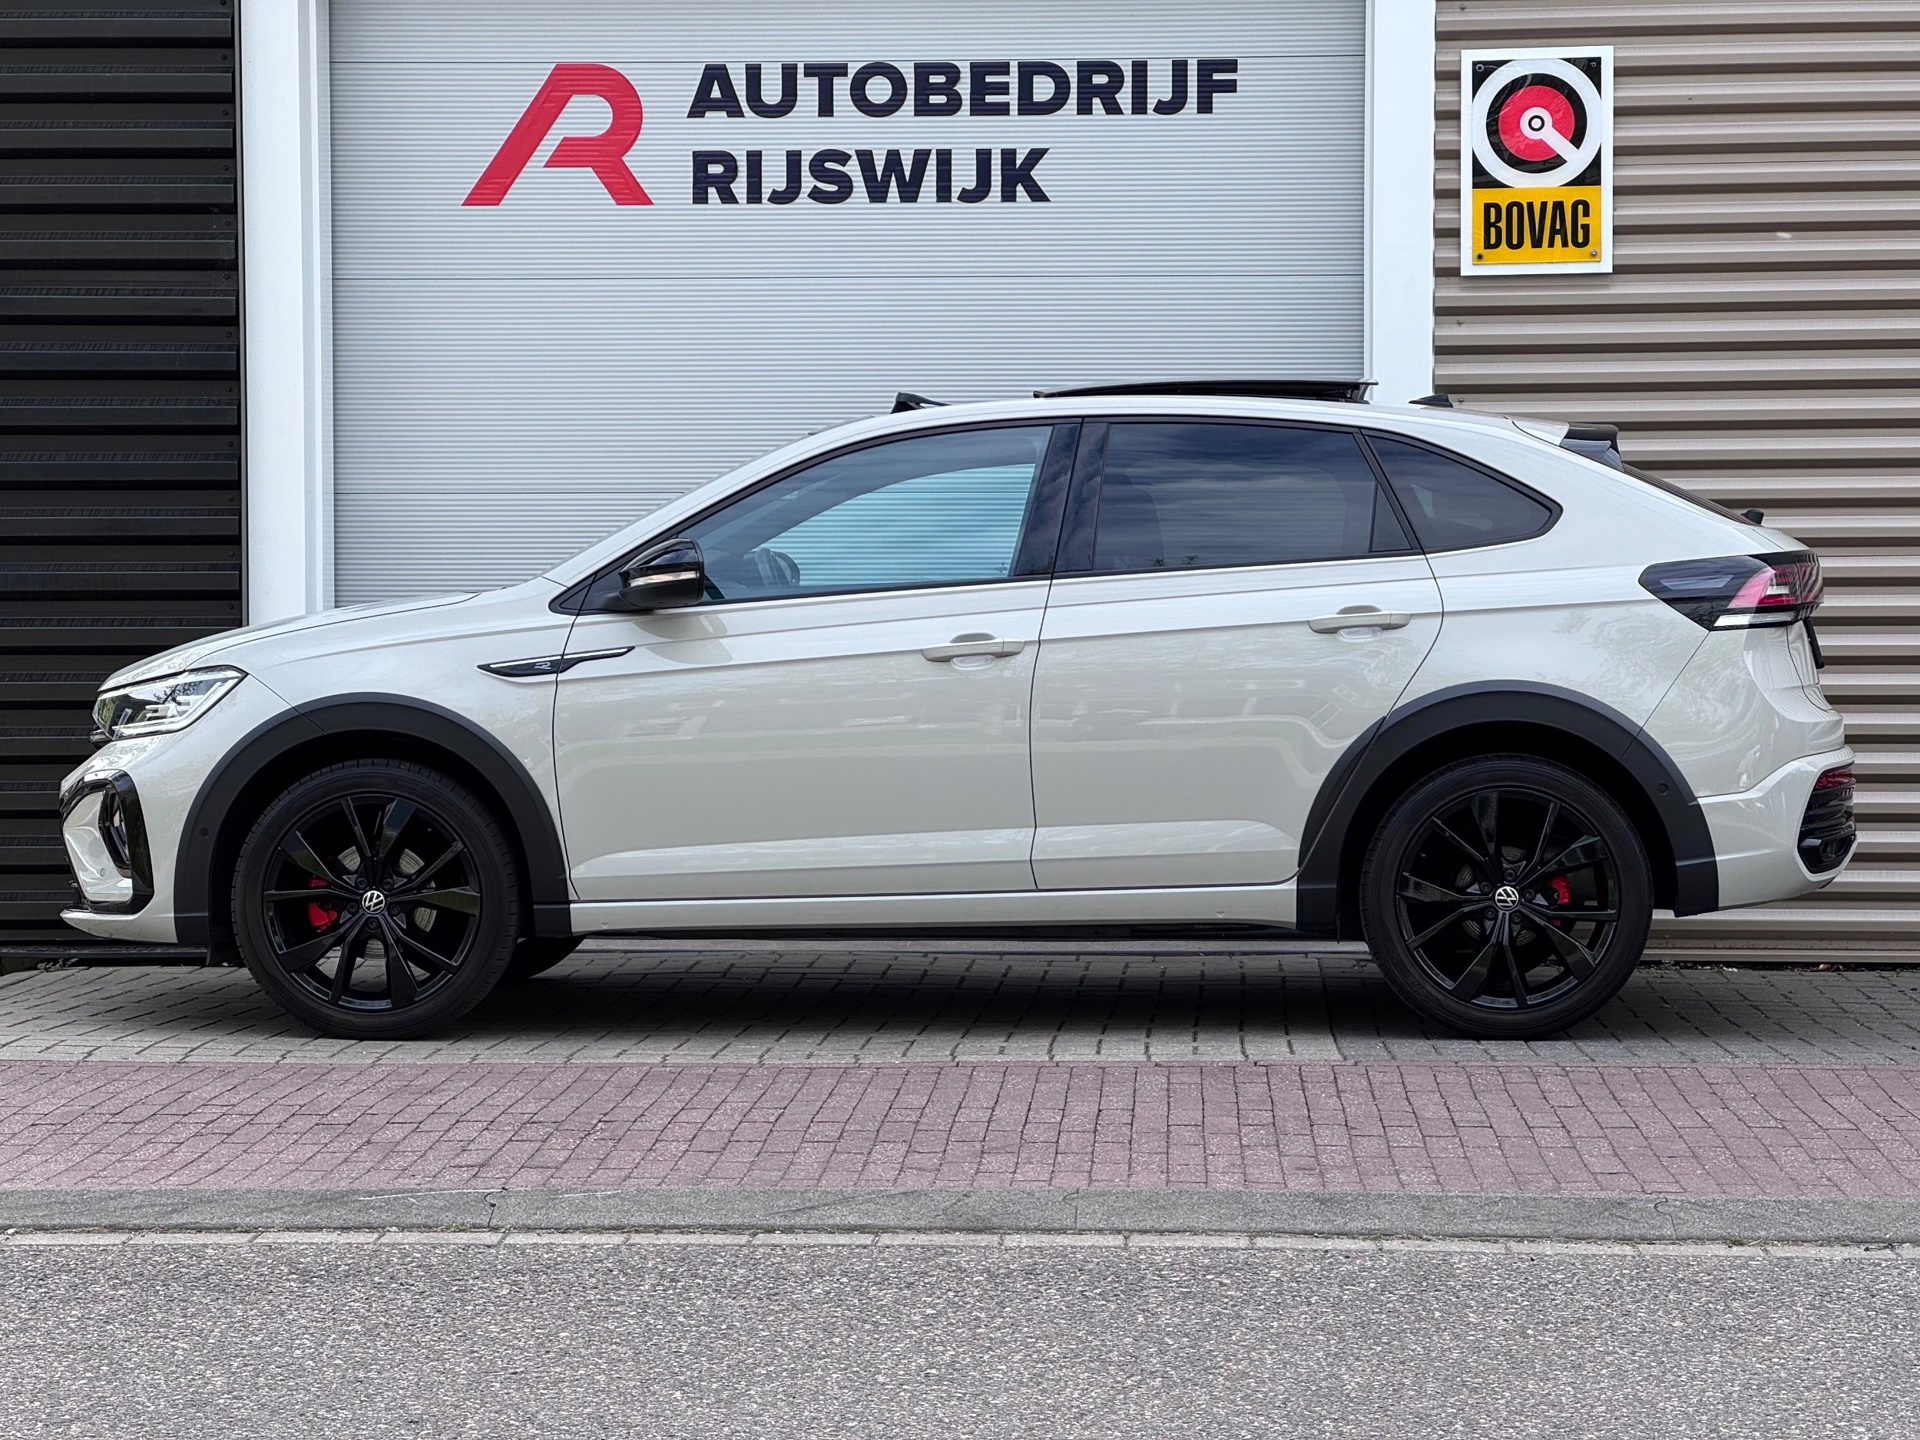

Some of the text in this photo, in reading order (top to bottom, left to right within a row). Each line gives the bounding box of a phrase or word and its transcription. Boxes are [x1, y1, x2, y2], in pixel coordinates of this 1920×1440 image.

[687, 59, 1238, 119] AUTOBEDRIJF
[692, 147, 1051, 205] RIJSWIJK
[1483, 199, 1590, 250] BOVAG
[363, 891, 385, 913] VW
[1495, 887, 1519, 910] VW
